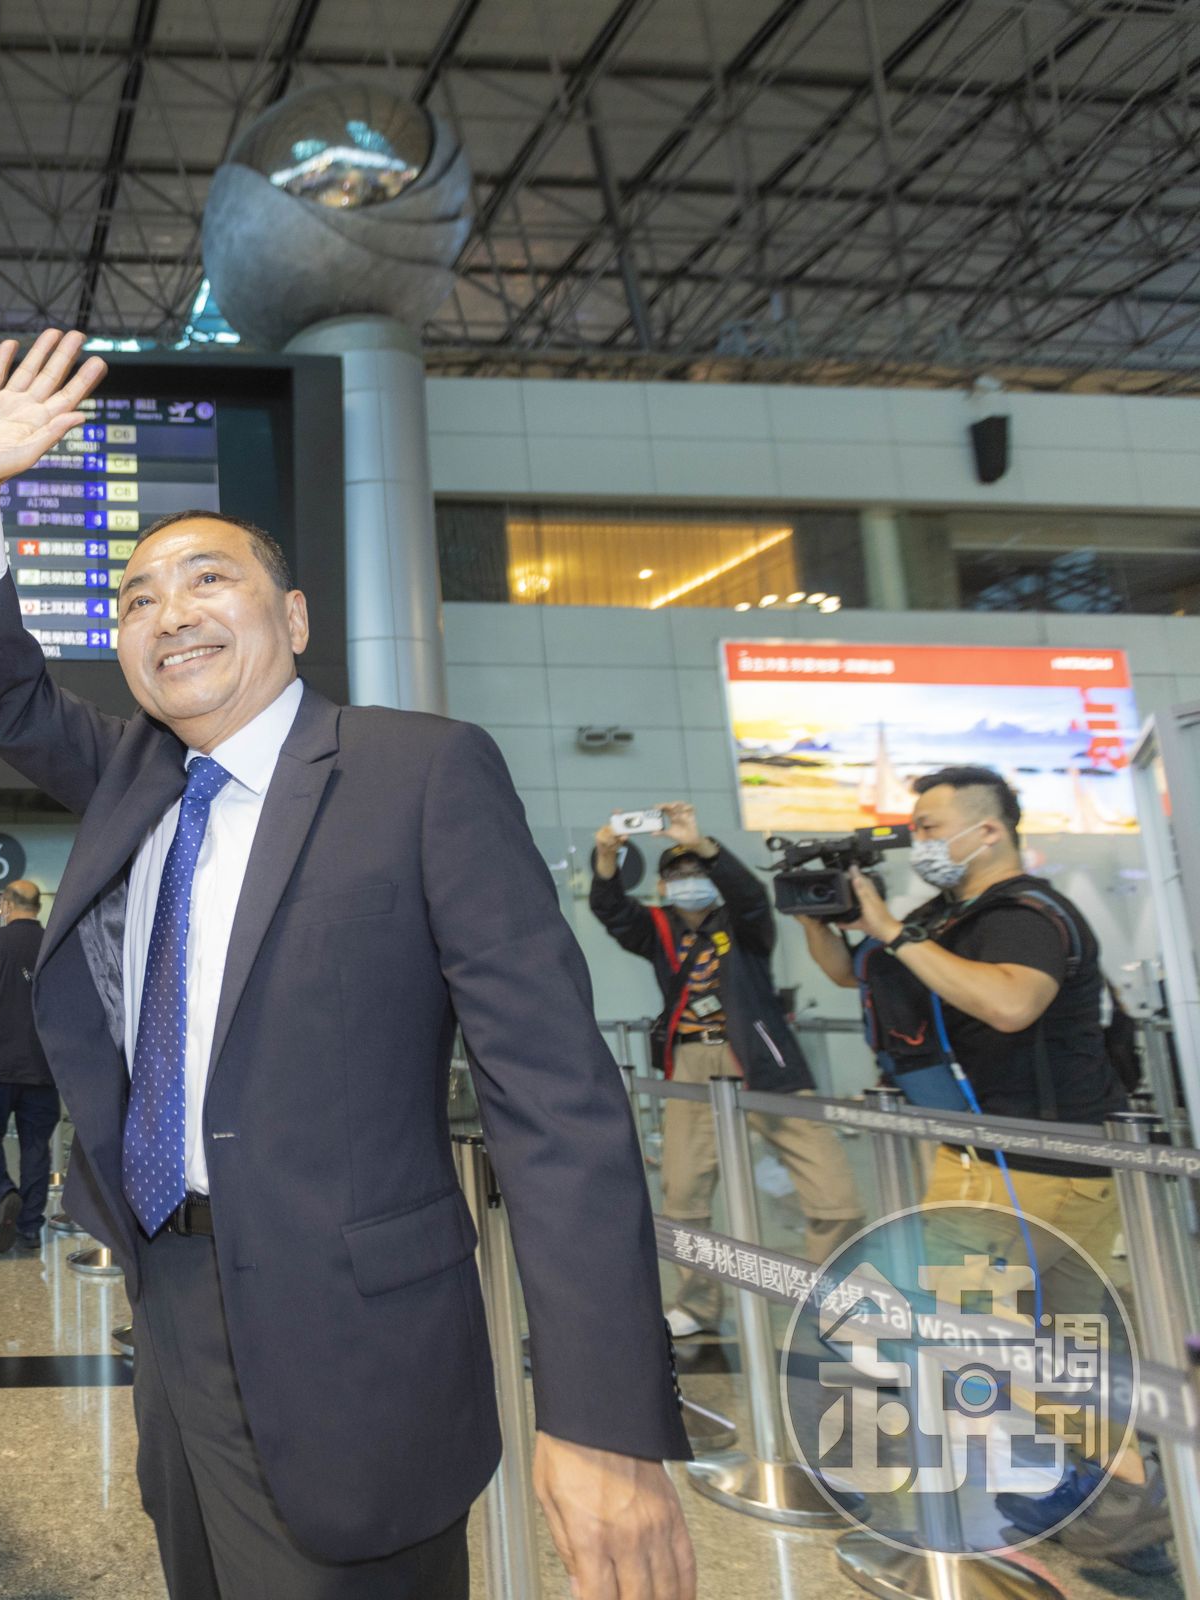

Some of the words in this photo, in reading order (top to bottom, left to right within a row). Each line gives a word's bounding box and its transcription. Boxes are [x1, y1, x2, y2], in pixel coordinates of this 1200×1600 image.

[94, 603, 104, 614] 4
[91, 633, 107, 645] 21
[926, 1119, 975, 1139] Taiwan
[975, 1126, 1040, 1151] Taoyuan
[1043, 1135, 1153, 1165] International
[1156, 1151, 1200, 1176] Airp
